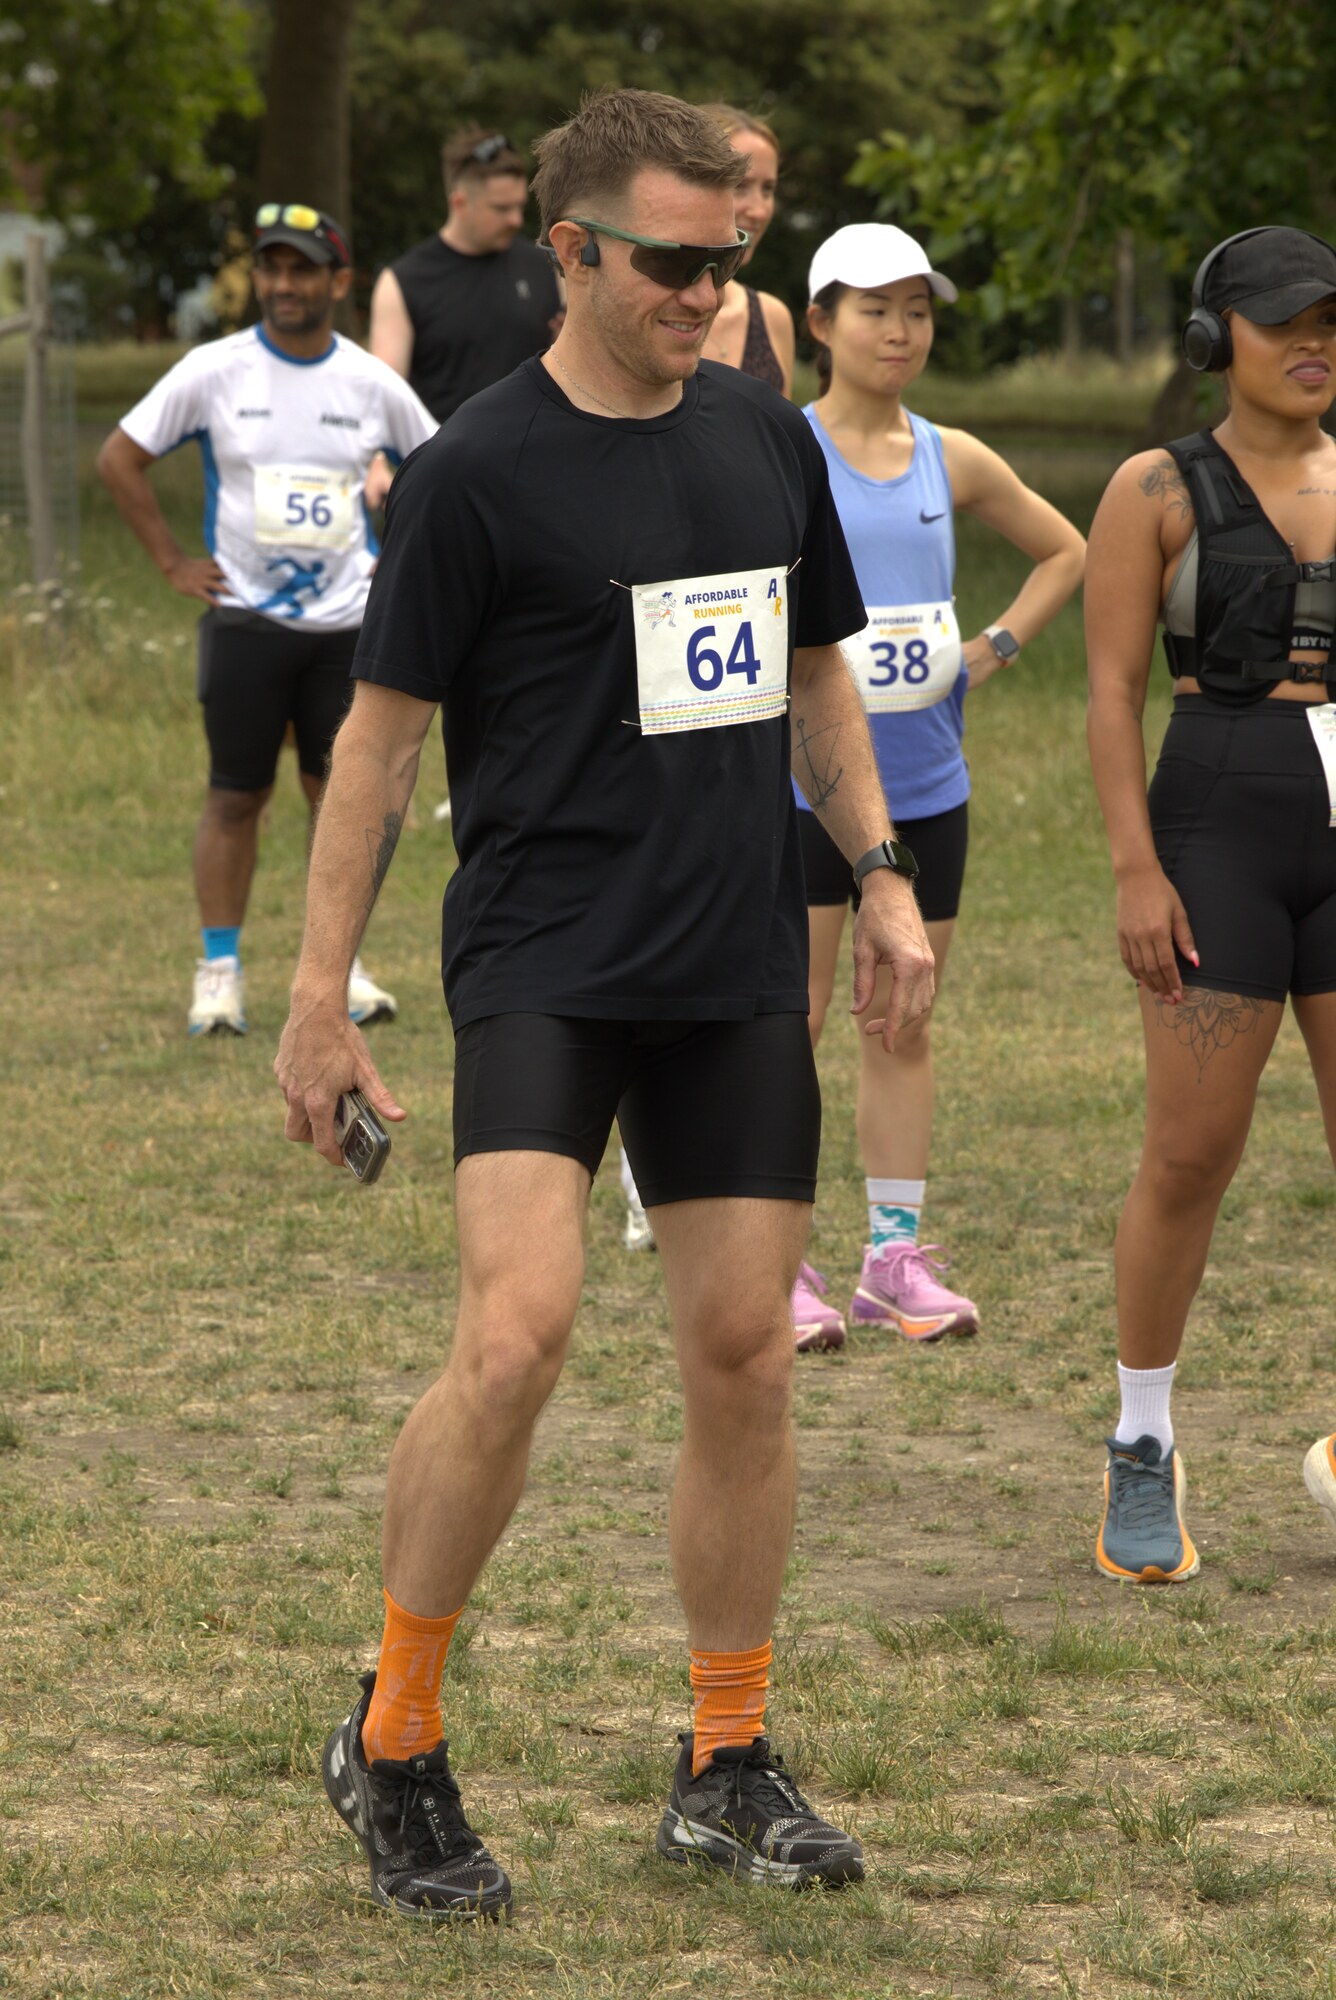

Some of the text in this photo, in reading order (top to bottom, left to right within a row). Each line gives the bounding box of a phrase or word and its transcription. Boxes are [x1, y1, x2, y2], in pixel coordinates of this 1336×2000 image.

[285, 493, 333, 527] 56
[684, 588, 748, 605] AFFORDABLE
[767, 578, 777, 599] A
[693, 604, 743, 619] RUNNING
[774, 596, 782, 616] R
[686, 621, 761, 692] 64
[868, 638, 930, 687] 38
